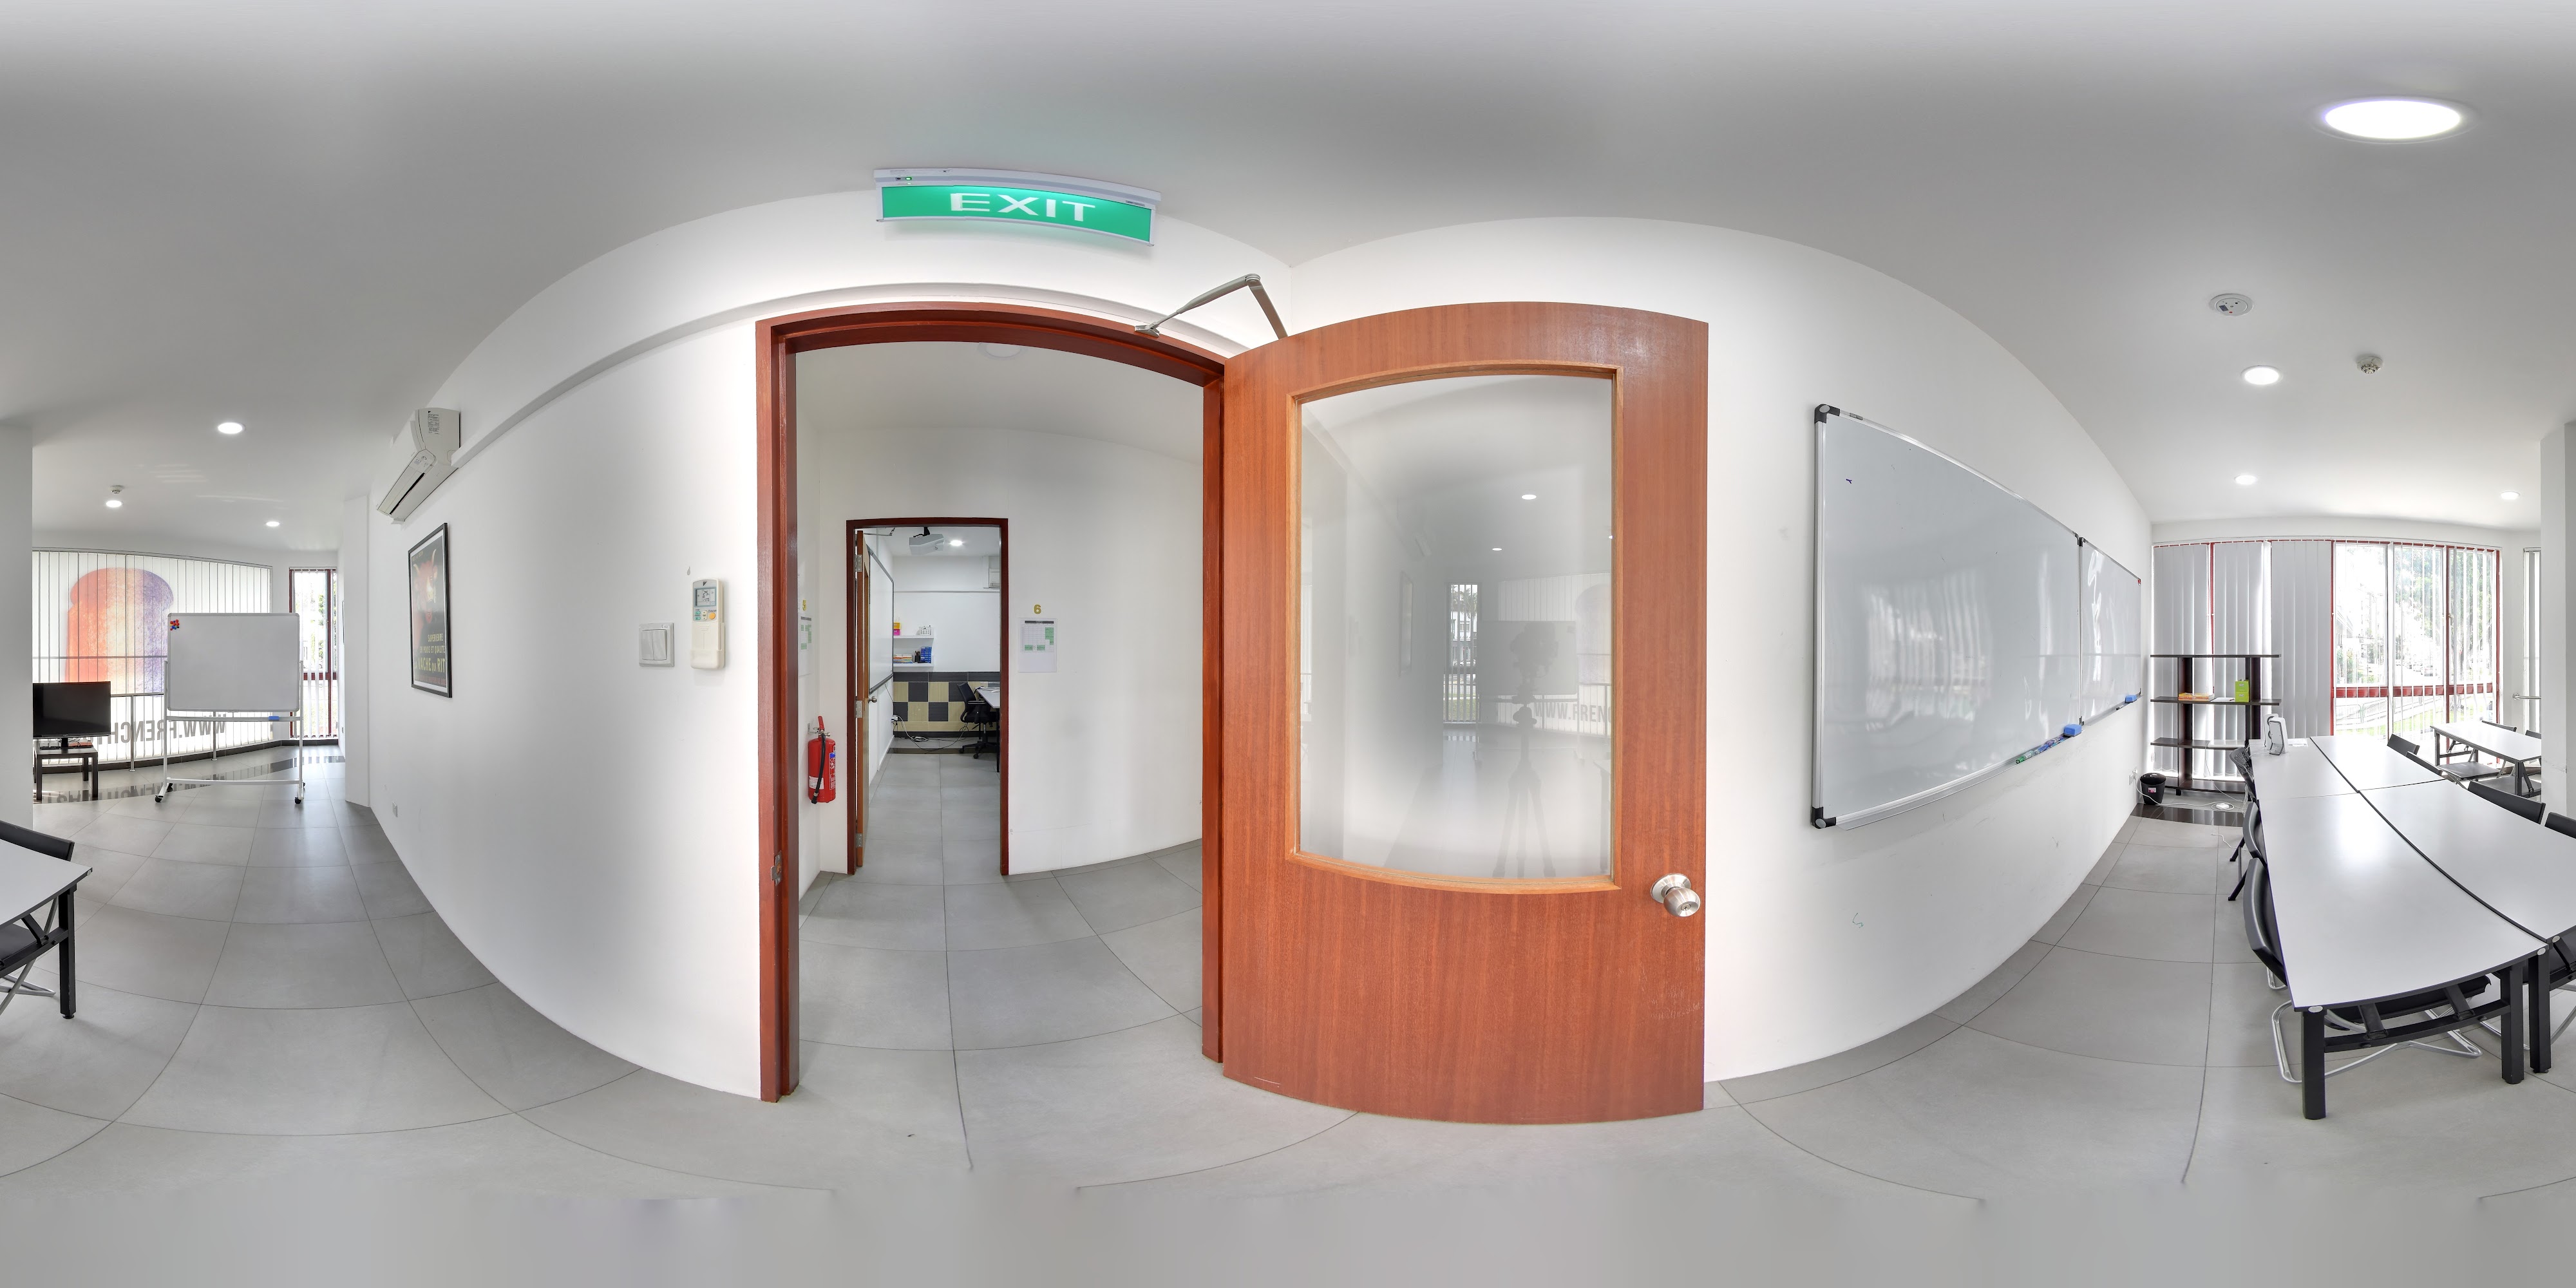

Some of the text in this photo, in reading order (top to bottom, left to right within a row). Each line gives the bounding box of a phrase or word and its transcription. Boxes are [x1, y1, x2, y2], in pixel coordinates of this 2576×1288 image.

[950, 193, 1095, 222] EXIT
[1034, 604, 1041, 614] 6
[418, 657, 431, 671] VACHE
